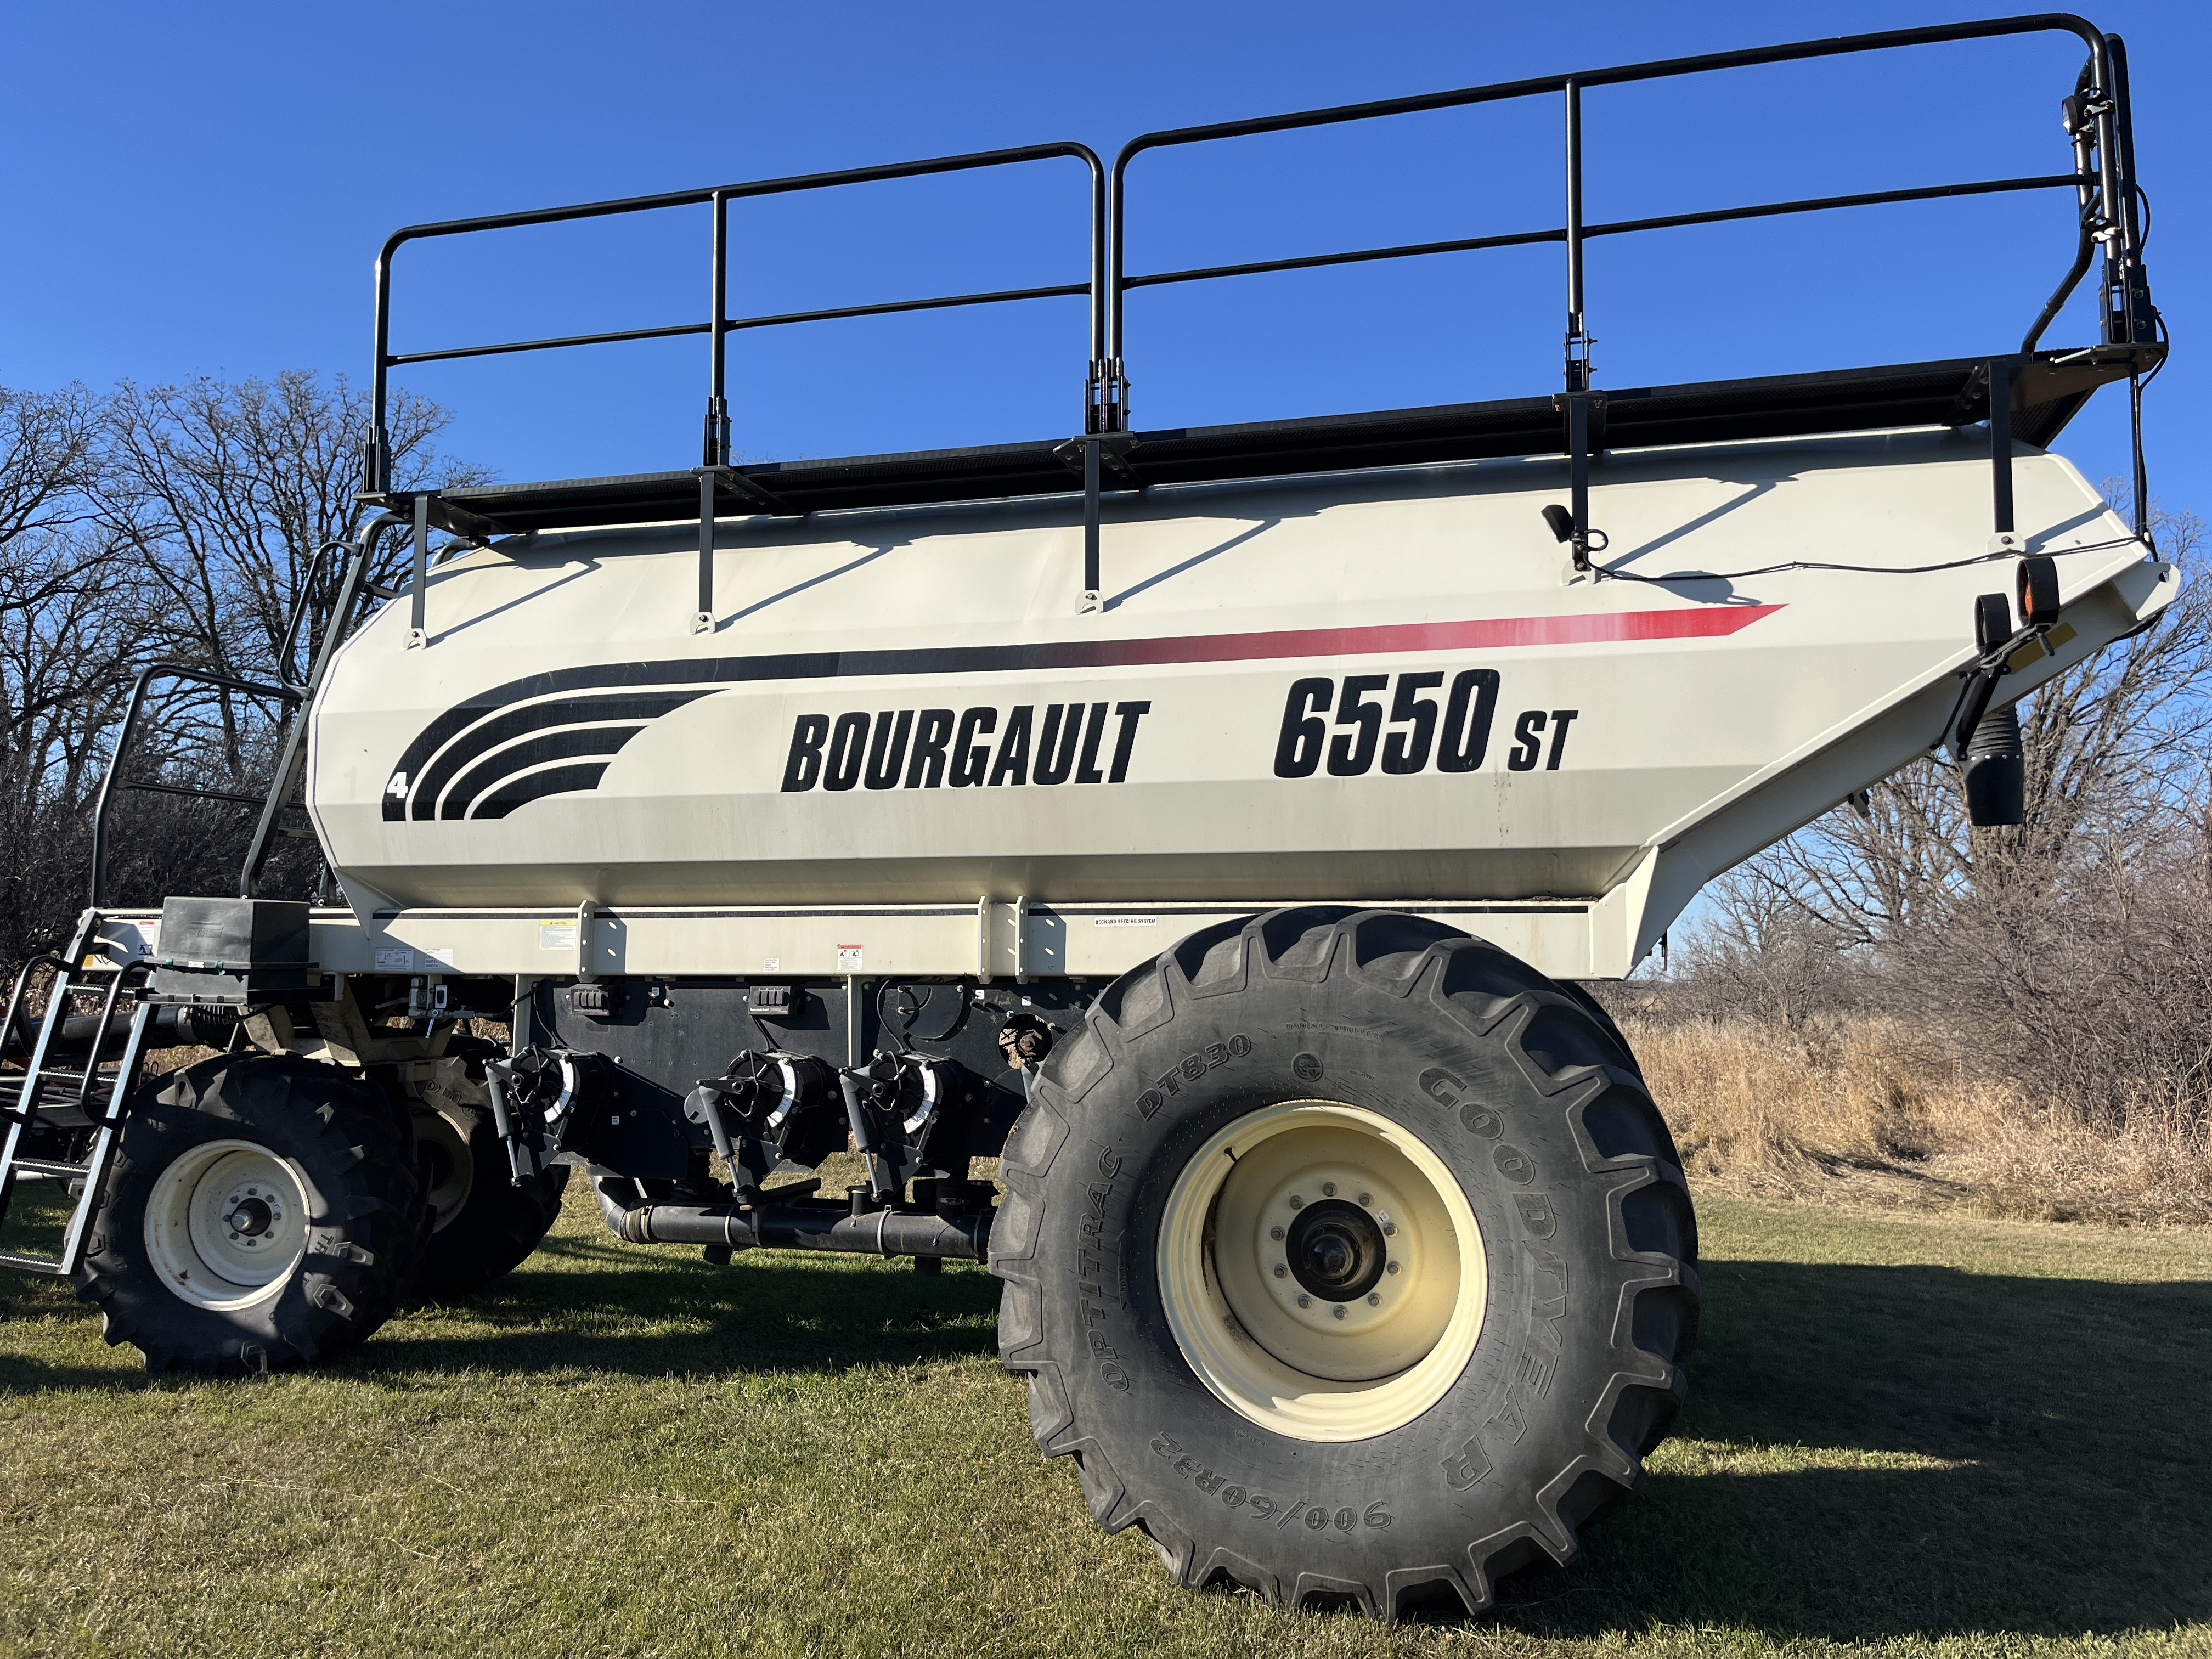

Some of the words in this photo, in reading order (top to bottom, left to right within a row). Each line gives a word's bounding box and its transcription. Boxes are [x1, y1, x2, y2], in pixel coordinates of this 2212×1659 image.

[780, 701, 1152, 792] BOURGAULT
[1273, 669, 1500, 778] 6550
[1508, 709, 1579, 771] ST
[387, 771, 408, 798] 4
[1135, 1032, 1251, 1122] DT830
[1078, 1146, 1130, 1392] OPTITRAC
[1418, 1067, 1569, 1492] GOODYEAR
[1150, 1431, 1392, 1532] 900/60R32
